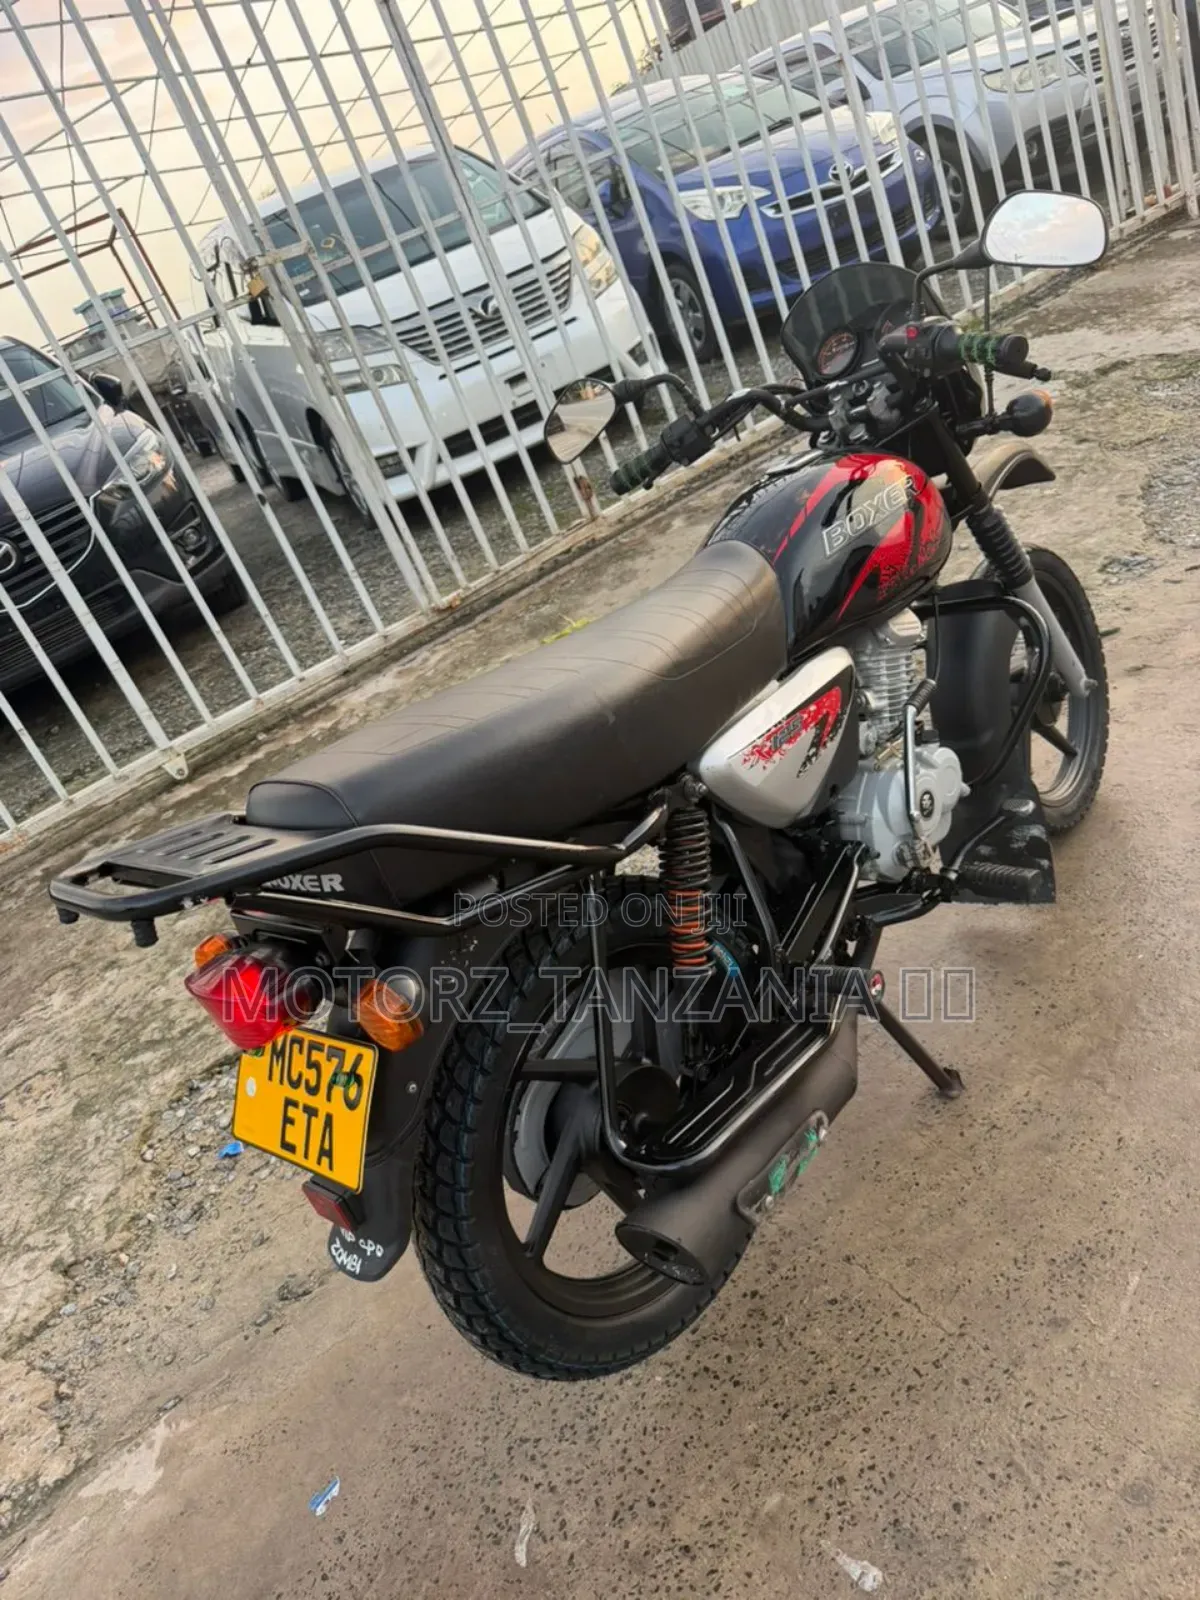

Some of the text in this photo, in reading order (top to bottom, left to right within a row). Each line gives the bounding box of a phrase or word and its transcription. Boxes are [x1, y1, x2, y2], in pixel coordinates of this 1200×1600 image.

[821, 474, 920, 557] BOXER
[267, 1033, 365, 1112] MC576
[279, 1096, 334, 1172] ETA
